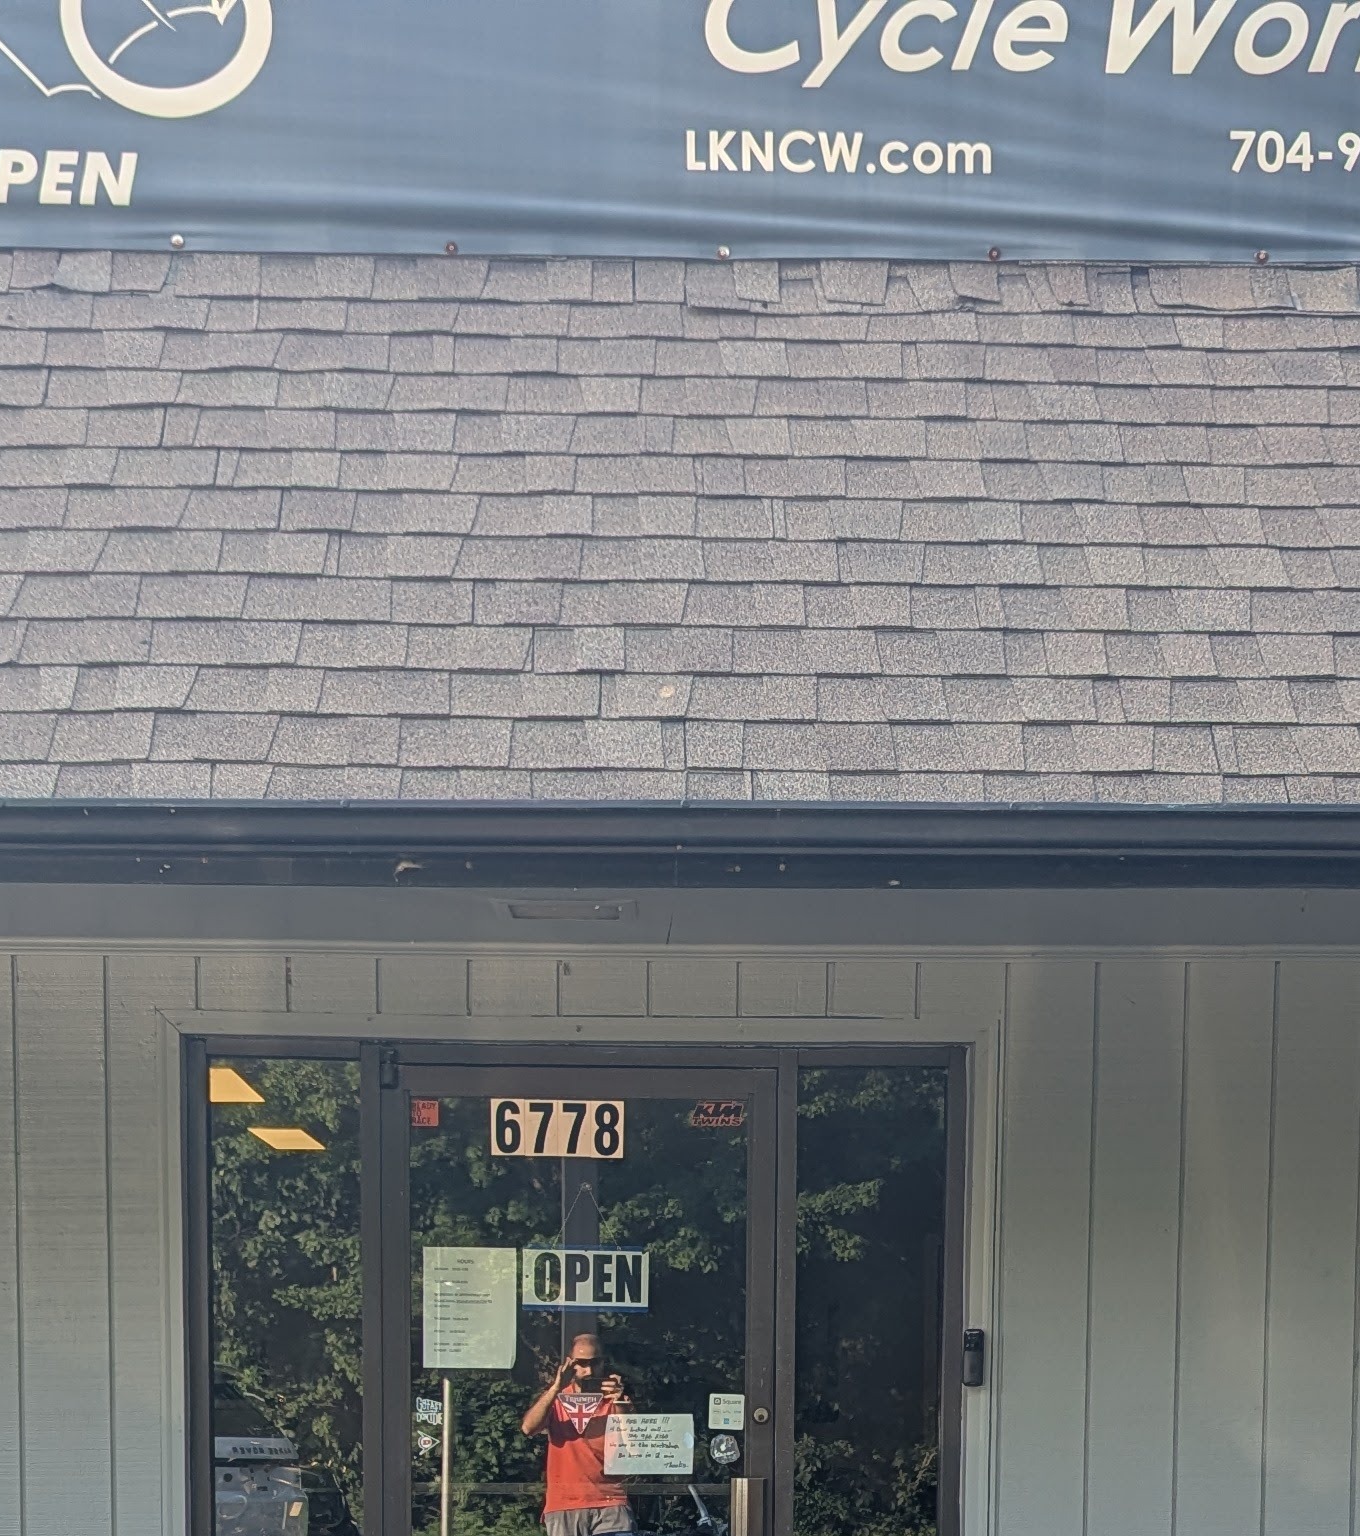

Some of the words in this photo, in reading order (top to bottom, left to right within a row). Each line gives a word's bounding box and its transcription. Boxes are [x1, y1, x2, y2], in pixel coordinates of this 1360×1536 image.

[705, 0, 1069, 88] Cycle
[686, 129, 992, 174] LKNCW.com
[495, 1100, 620, 1156] 6778
[693, 1101, 743, 1117] KTM
[693, 1117, 741, 1126] TWINS
[534, 1252, 642, 1303] OPEN
